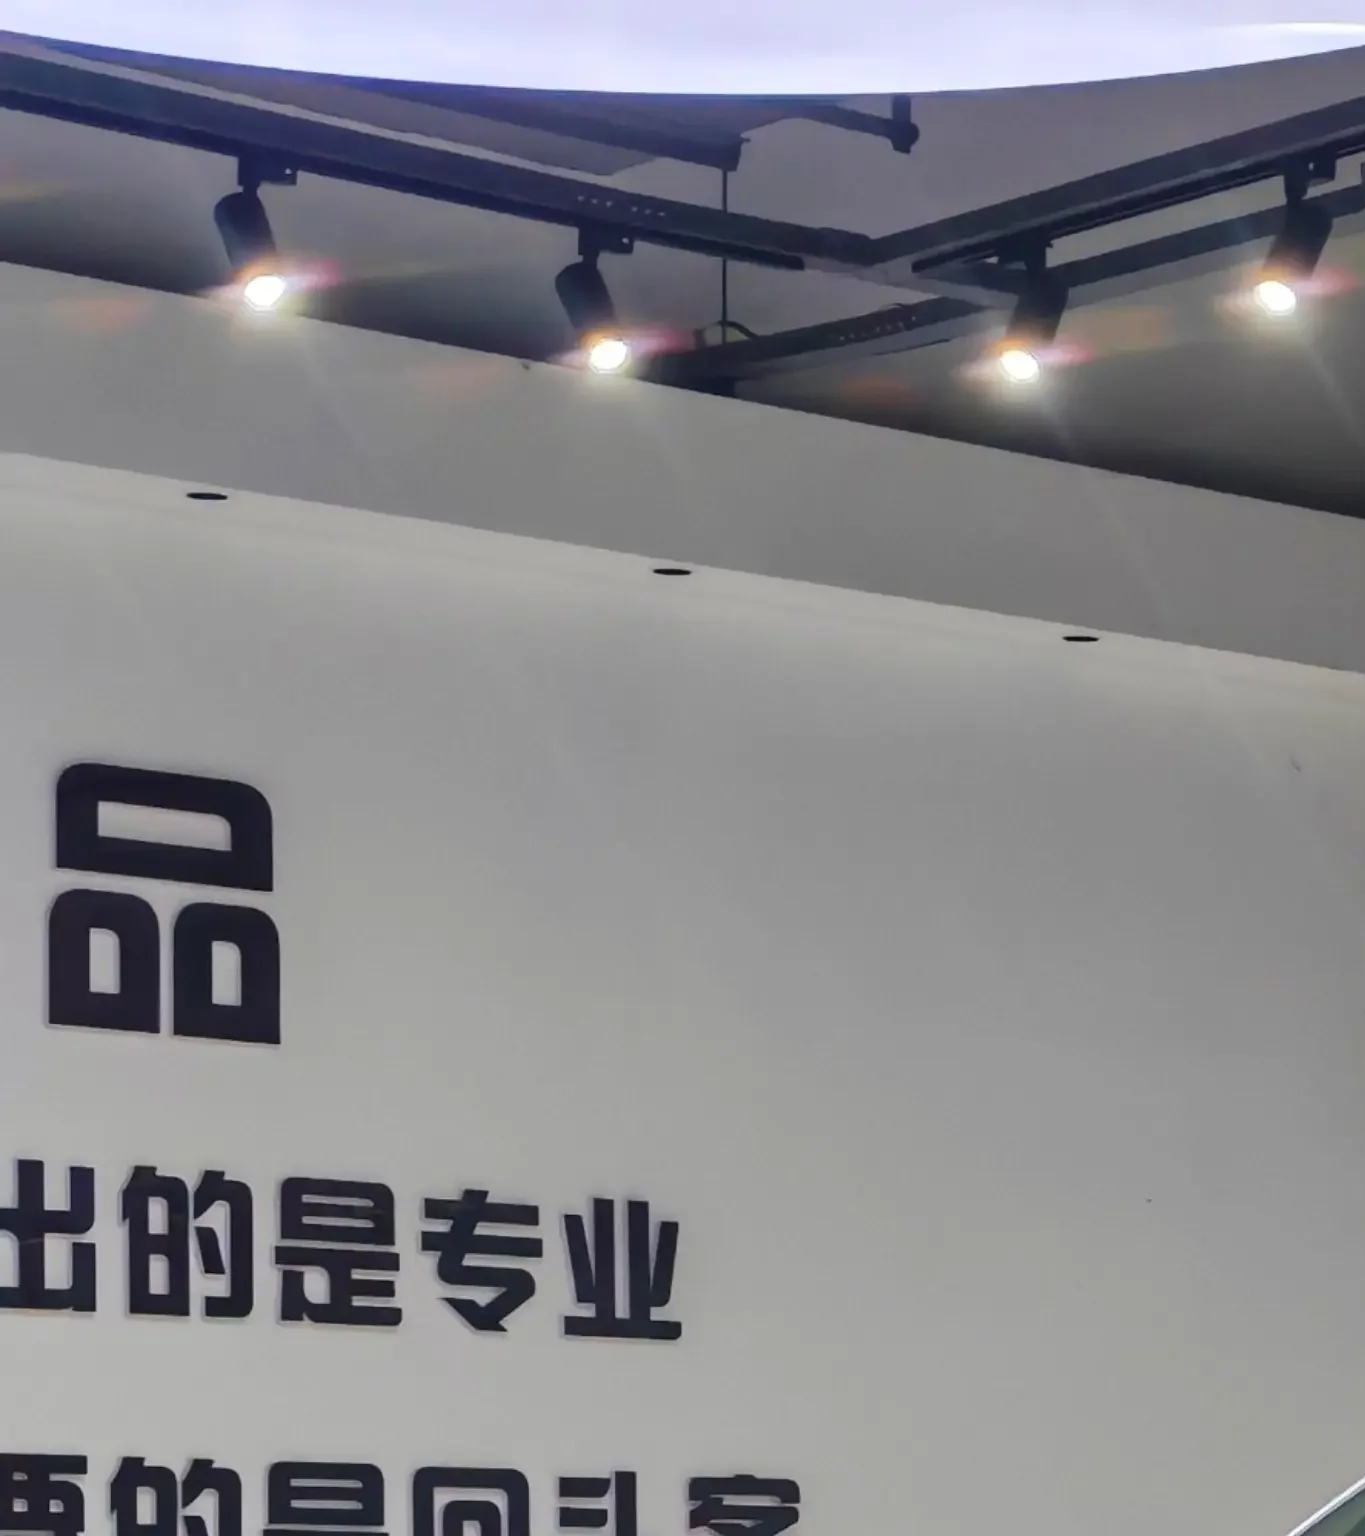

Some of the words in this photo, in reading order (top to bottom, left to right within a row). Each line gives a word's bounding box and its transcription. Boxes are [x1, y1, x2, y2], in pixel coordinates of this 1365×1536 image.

[49, 763, 281, 1045] 品
[0, 1159, 683, 1341] 出的是专业
